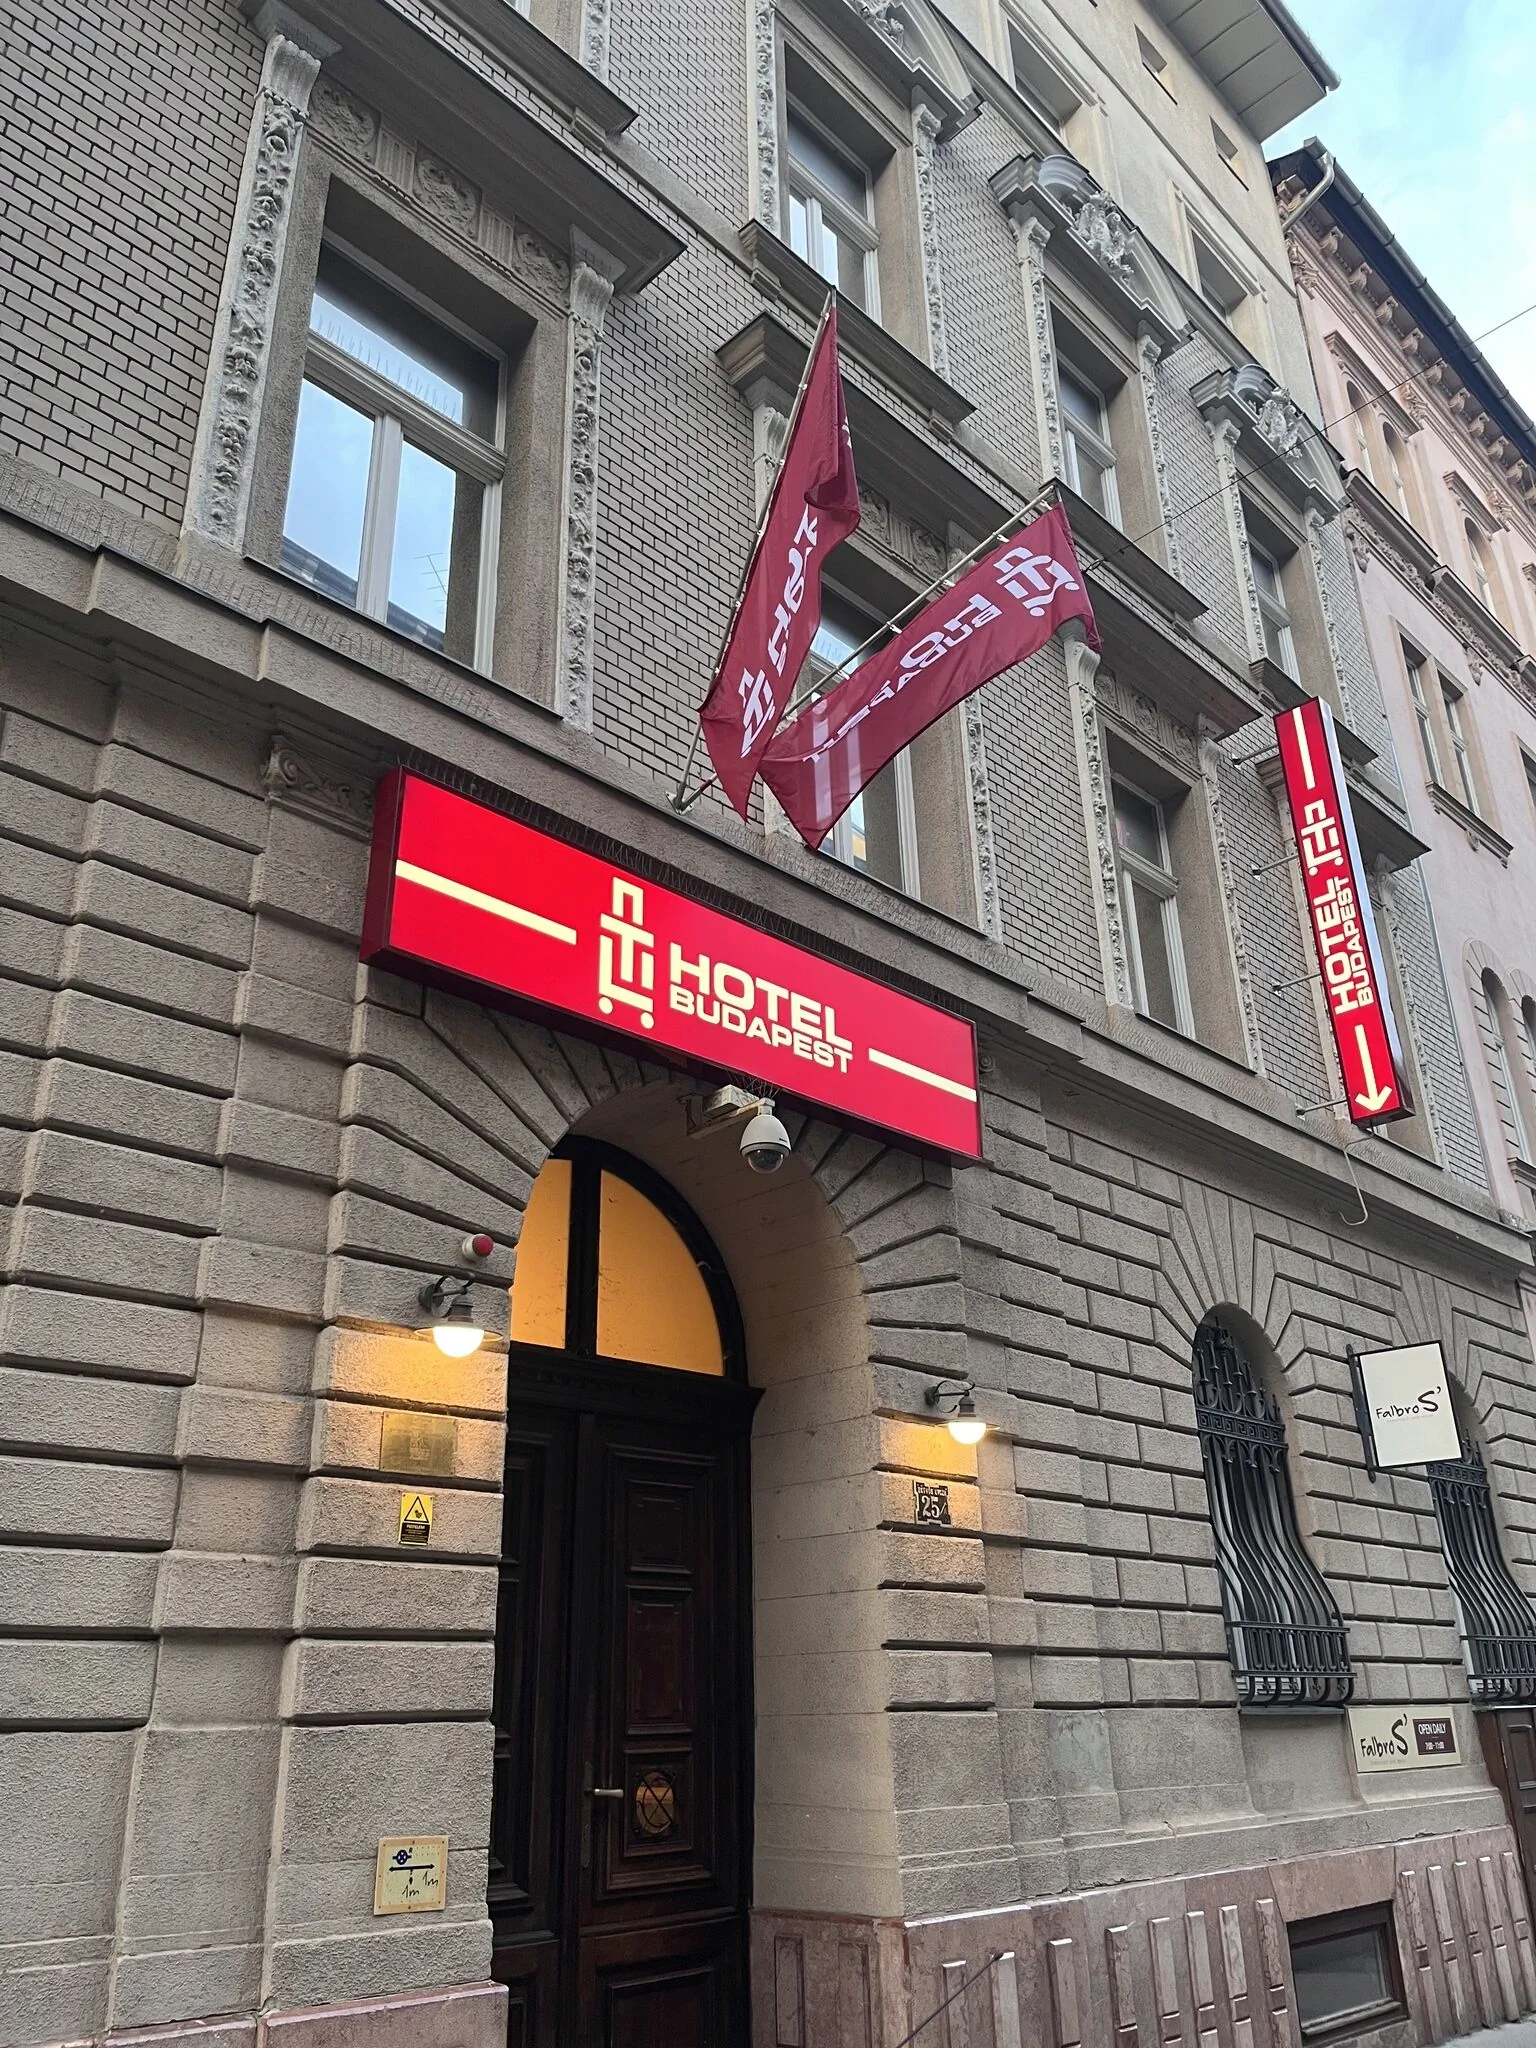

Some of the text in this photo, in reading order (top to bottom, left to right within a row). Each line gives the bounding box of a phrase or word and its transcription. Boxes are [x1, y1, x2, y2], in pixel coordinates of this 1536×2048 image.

[1315, 879, 1358, 1014] HOTEL
[1335, 875, 1374, 1007] BUDAPEST
[669, 942, 853, 1052] HOTEL
[669, 984, 853, 1074] BUDAPEST
[1418, 1722, 1446, 1735] OPEN DAILY
